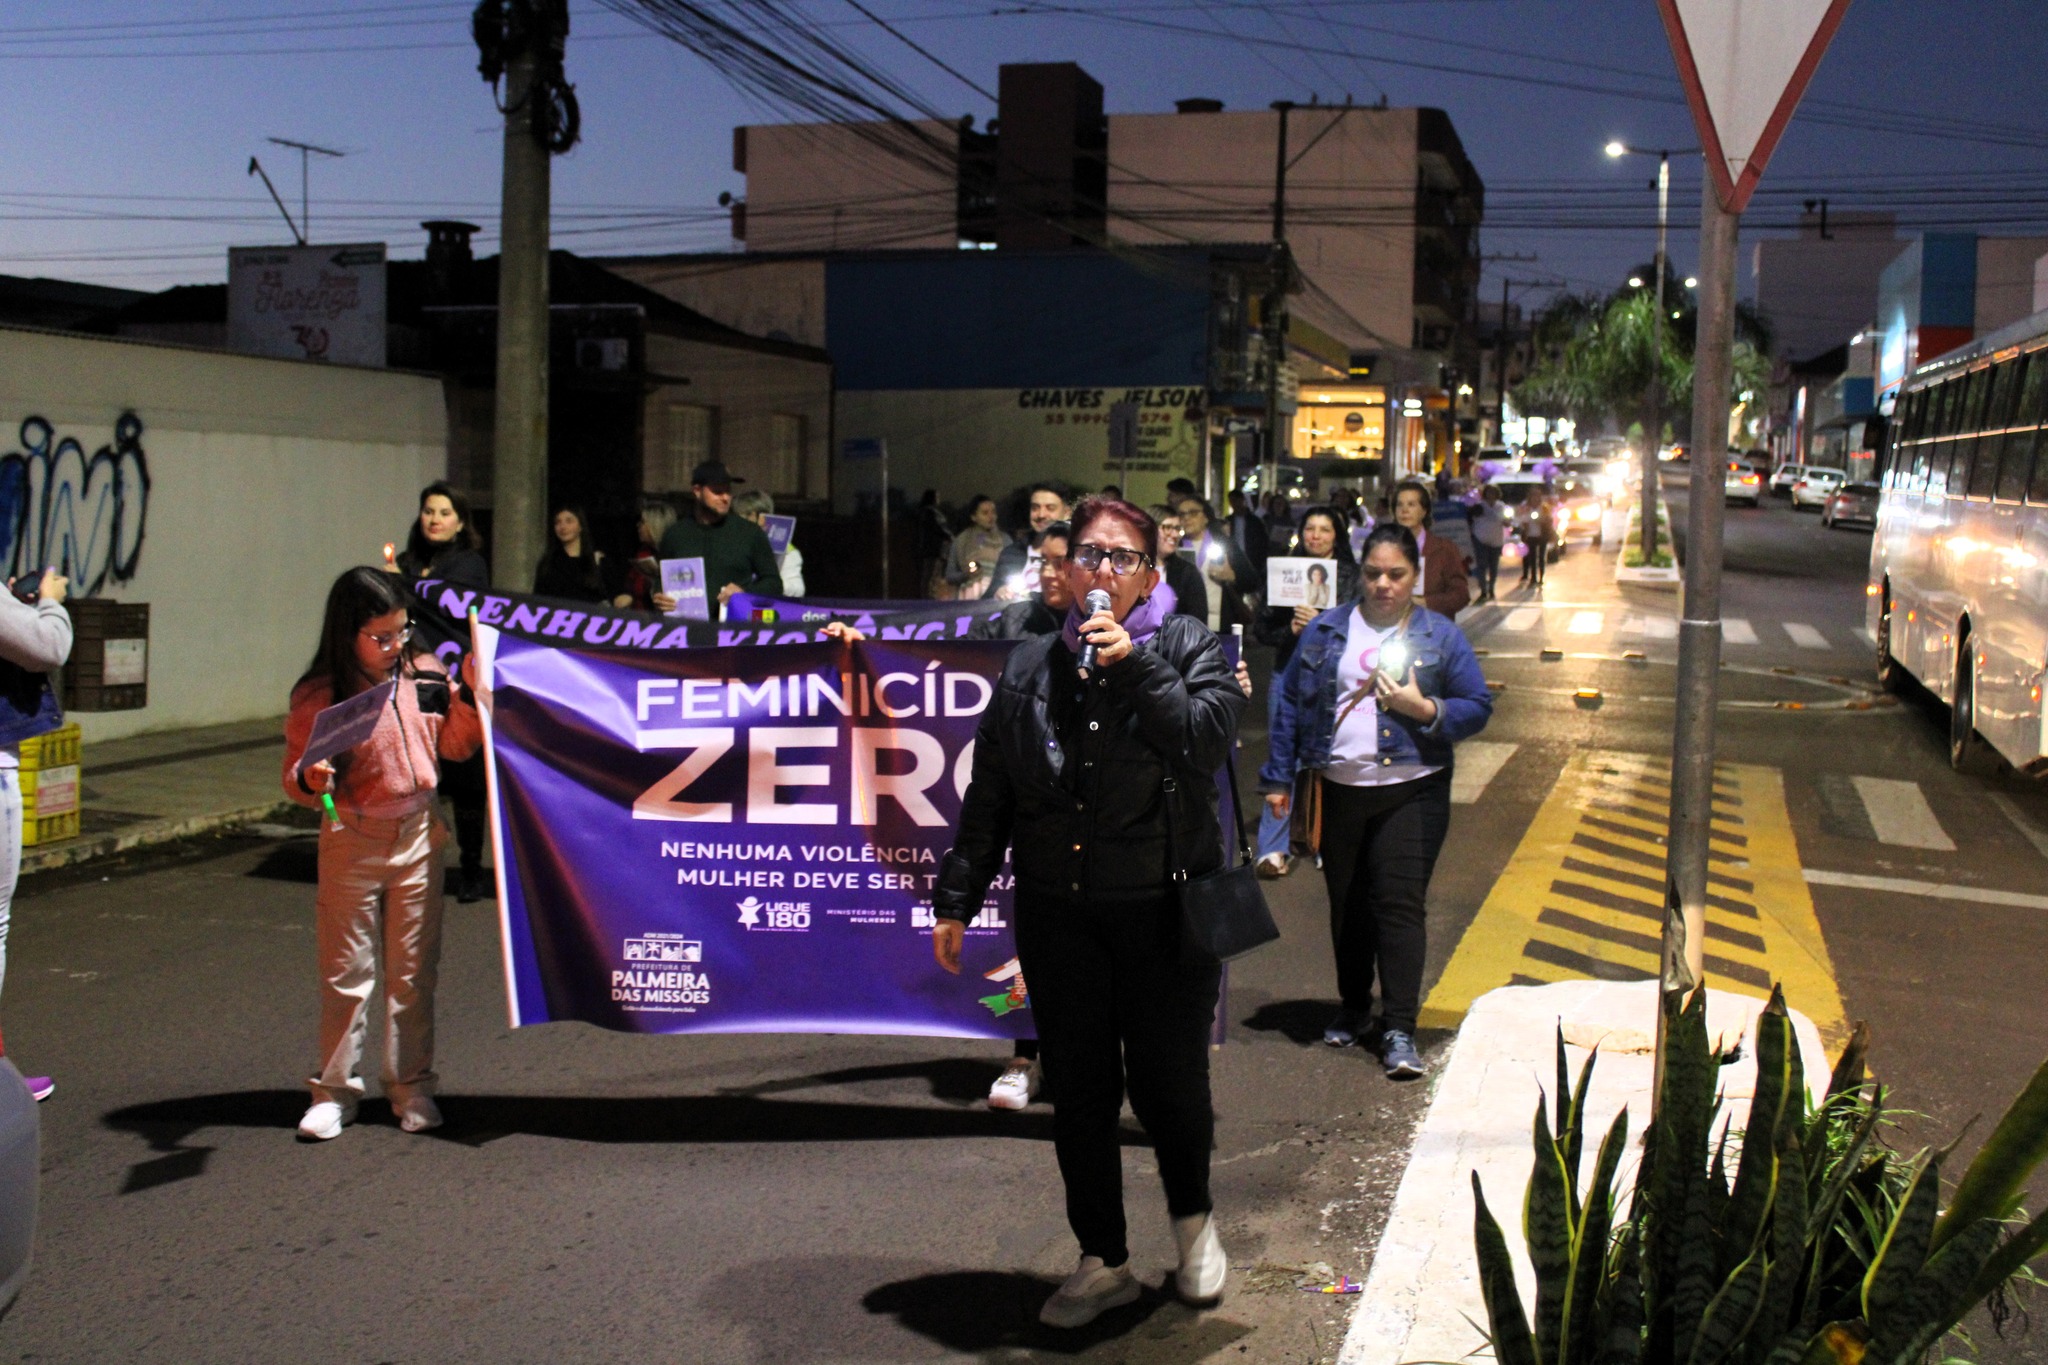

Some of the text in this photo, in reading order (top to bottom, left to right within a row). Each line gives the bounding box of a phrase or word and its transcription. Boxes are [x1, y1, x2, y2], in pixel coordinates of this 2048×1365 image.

[1018, 389, 1104, 408] CHAVES
[637, 660, 1001, 721] FEMINICÍD
[661, 841, 792, 861] NENHUMA
[800, 843, 936, 864] VIOLÊNCIA
[677, 868, 785, 888] MULHER
[793, 872, 860, 889] DEVE
[867, 873, 916, 890] SER
[765, 902, 811, 912] LIGUE
[826, 908, 876, 916] MINISTÉRIO
[766, 912, 811, 928] 180
[631, 963, 679, 971] PREFEITURA
[611, 970, 711, 990] PALMEIRA
[611, 987, 710, 1004] DAS MISSÕES
